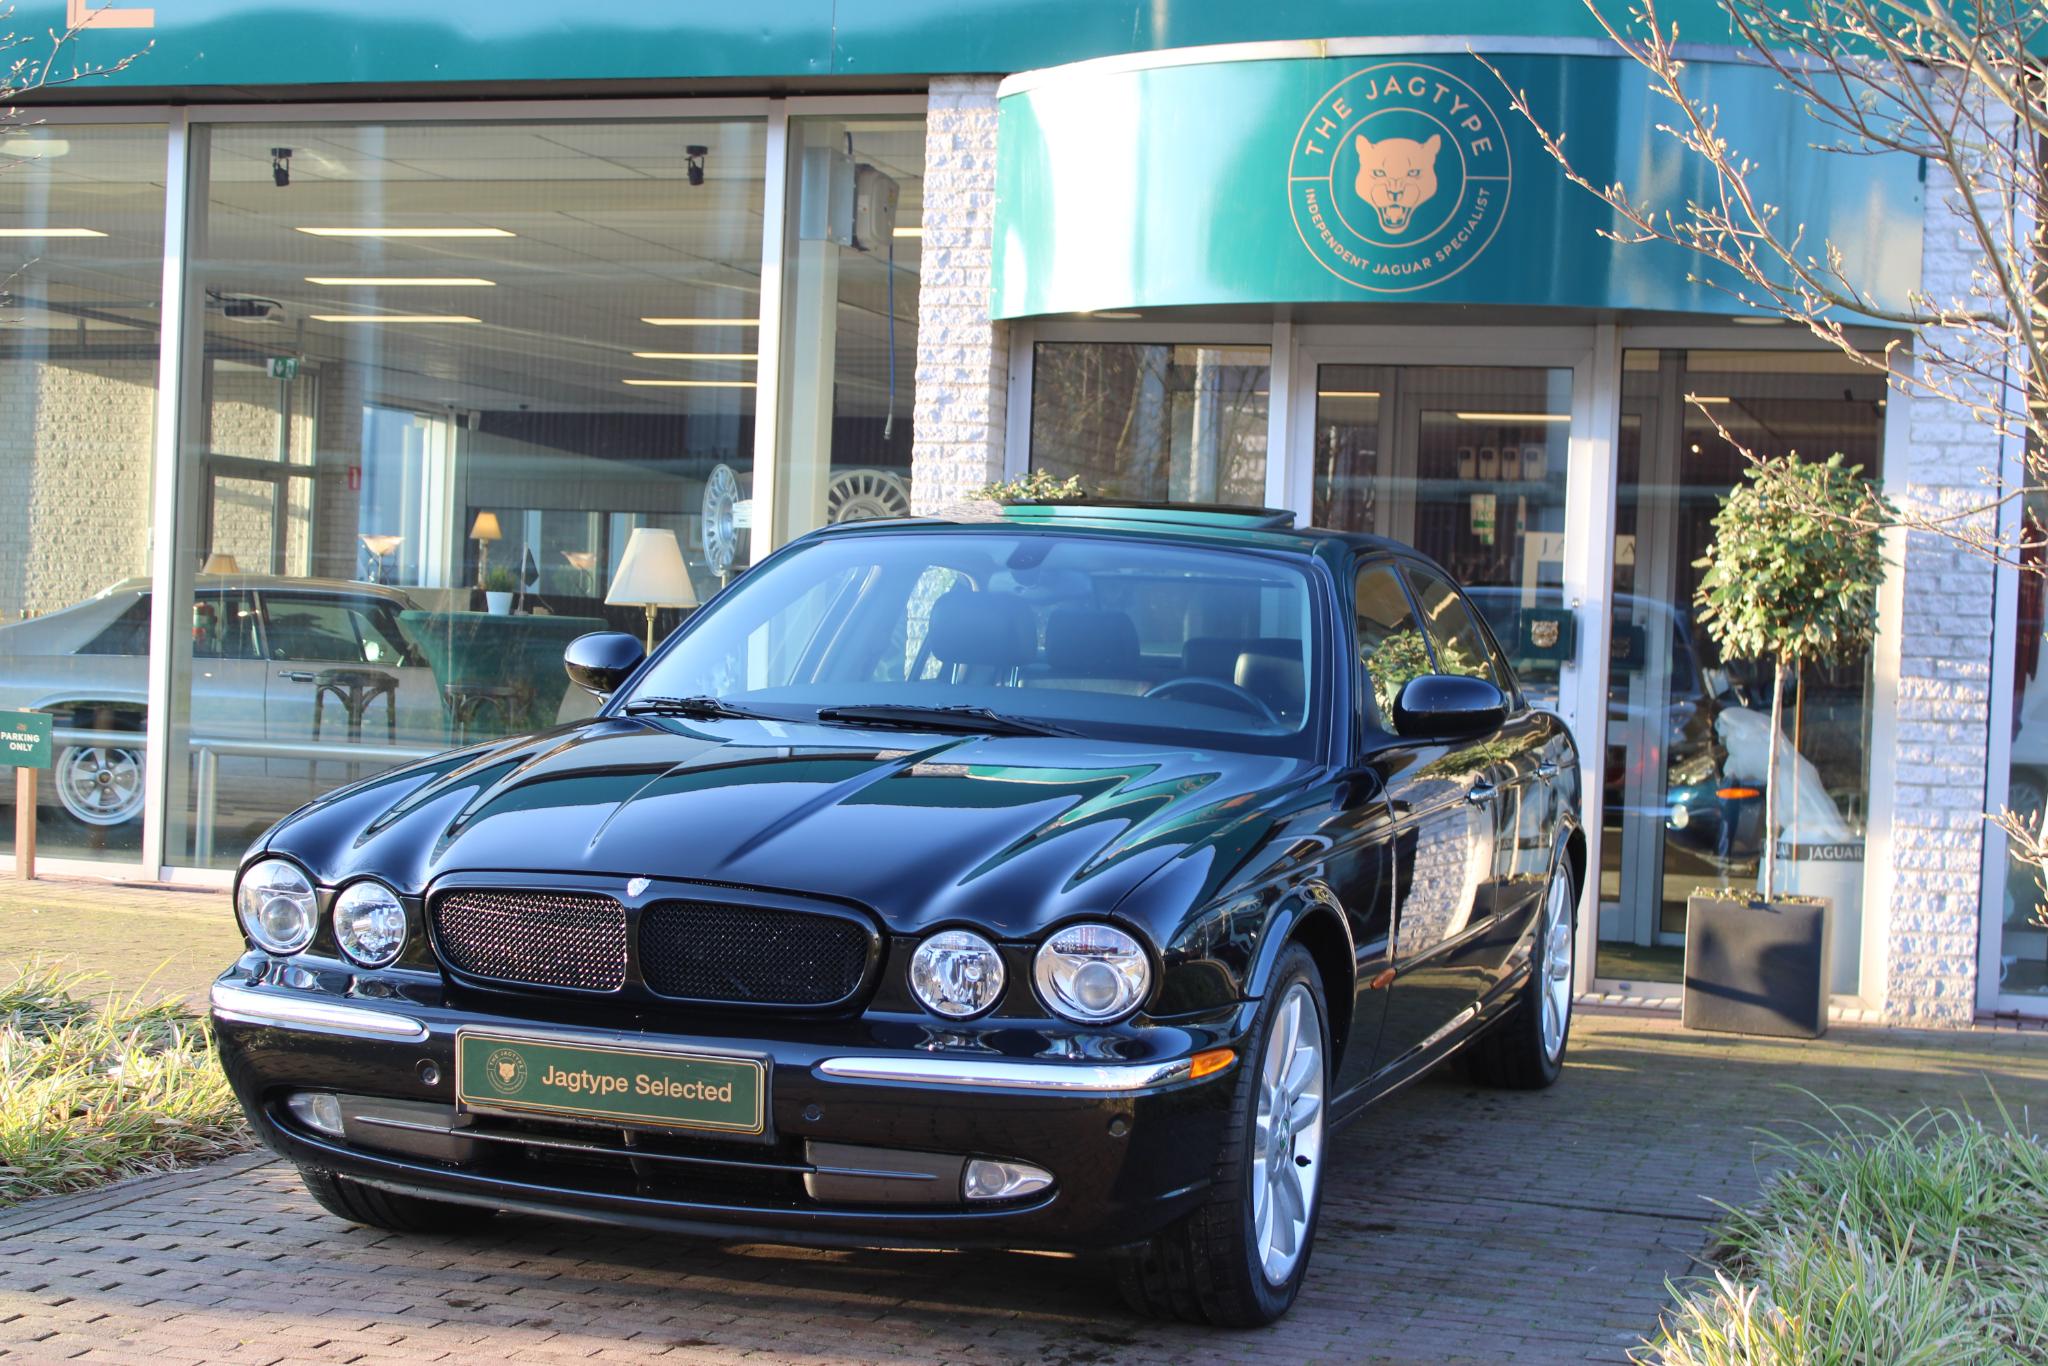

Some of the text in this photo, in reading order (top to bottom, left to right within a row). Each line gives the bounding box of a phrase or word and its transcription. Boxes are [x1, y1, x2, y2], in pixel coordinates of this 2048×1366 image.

[1305, 75, 1493, 157] THE JAGTYPE
[1305, 187, 1491, 277] INDEPENDENT JAGUAR SPECIALIST
[0, 731, 41, 743] PARKING
[9, 742, 34, 752] ONLY
[542, 1065, 629, 1095] Jagtype
[635, 1074, 732, 1103] Selected
